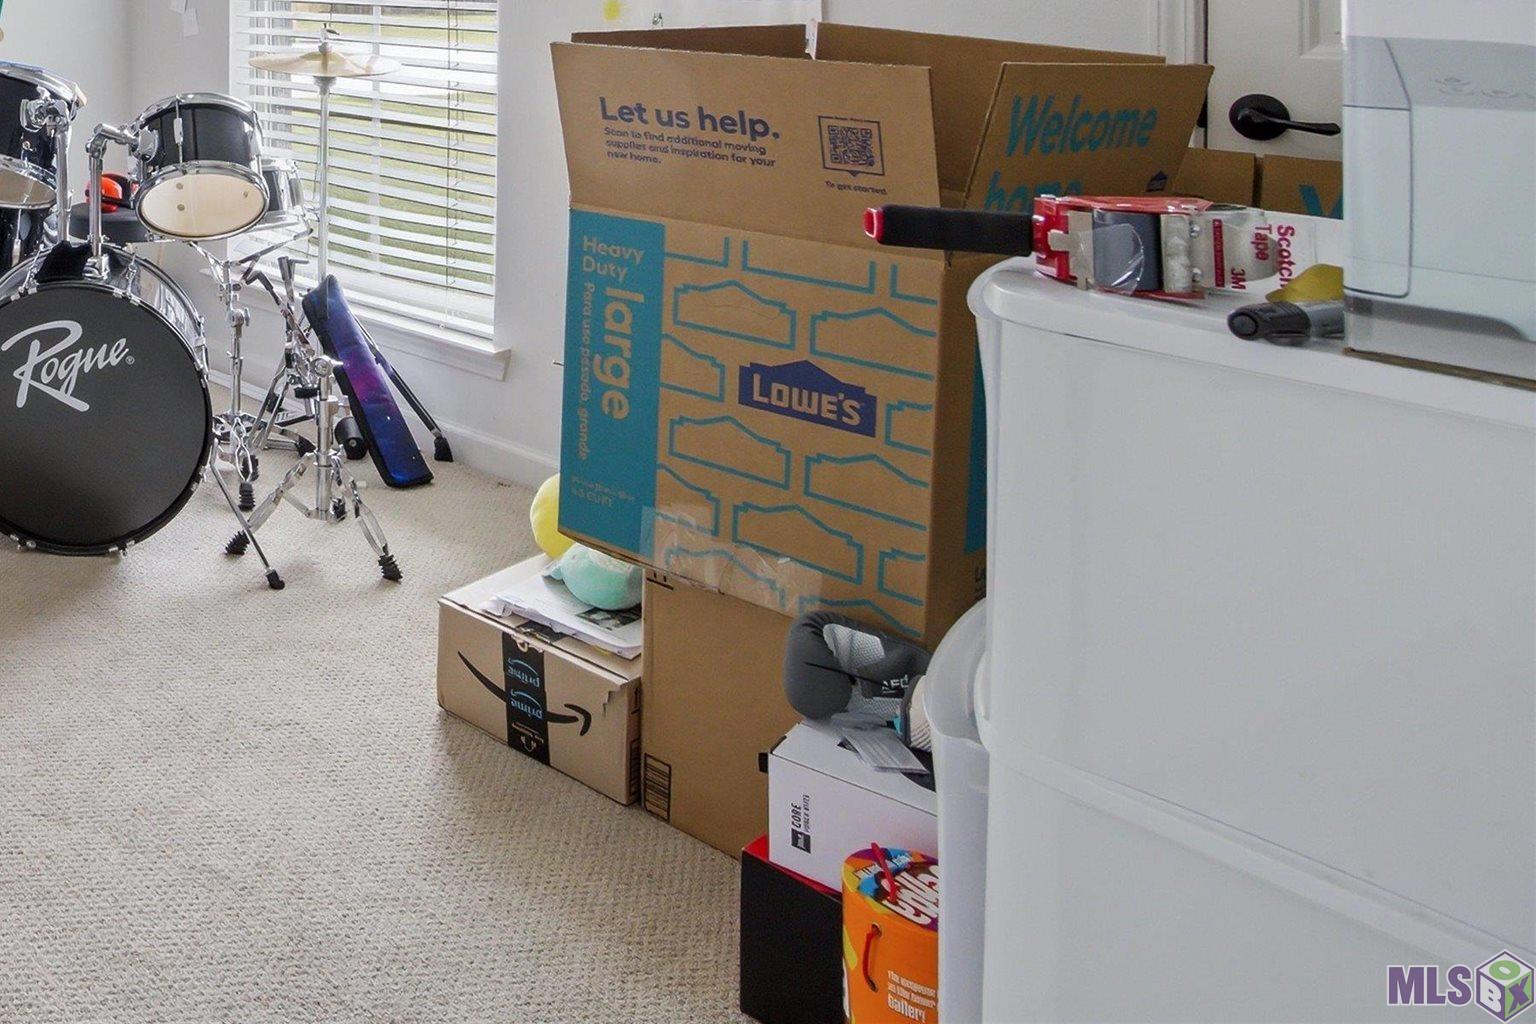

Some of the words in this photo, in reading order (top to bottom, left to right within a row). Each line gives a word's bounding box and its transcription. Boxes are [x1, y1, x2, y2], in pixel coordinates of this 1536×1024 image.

[599, 96, 649, 125] Let
[655, 108, 690, 129] us
[697, 106, 780, 141] help.
[1005, 90, 1159, 157] Welcome
[603, 126, 629, 138] Scan
[630, 130, 642, 139] to
[643, 131, 664, 142] find
[666, 133, 722, 148] additional
[724, 141, 767, 156] moving
[606, 139, 646, 152] supplies
[649, 143, 669, 154] and
[670, 144, 729, 161] inspiration
[731, 153, 747, 163] for
[750, 156, 776, 167] your
[607, 150, 627, 160] new
[629, 150, 661, 164] home.
[583, 235, 645, 264] Heavy
[1251, 224, 1272, 261] Tape
[583, 256, 627, 283] Duty
[1230, 267, 1246, 290] 3M
[582, 282, 595, 316] Para
[1, 319, 129, 412] Rogue
[593, 286, 645, 420] large
[752, 373, 861, 426] LOWE'S
[577, 407, 591, 461] grande
